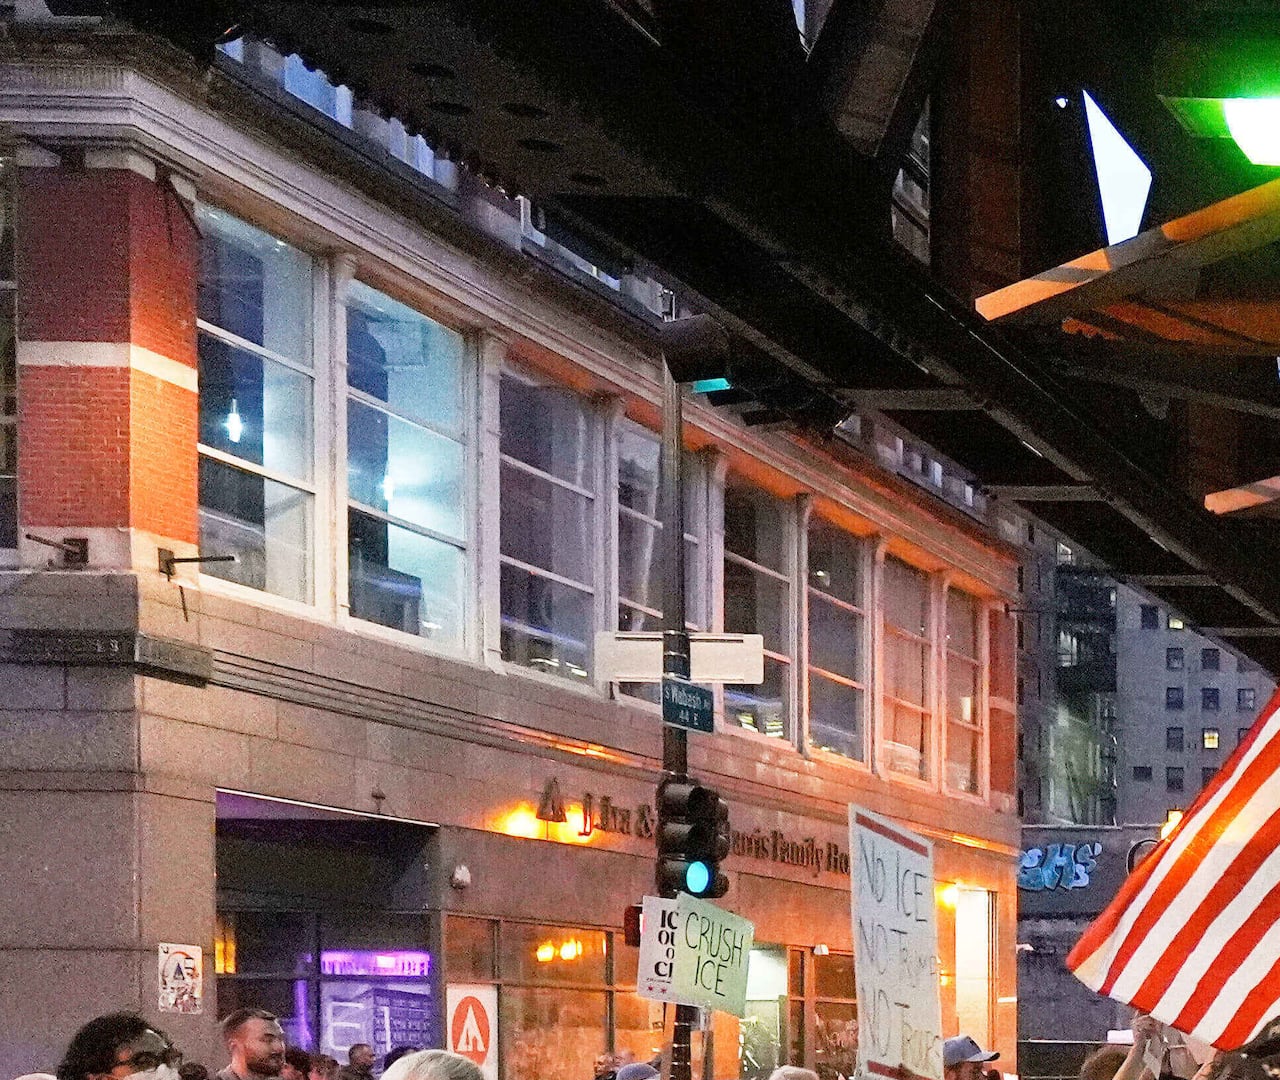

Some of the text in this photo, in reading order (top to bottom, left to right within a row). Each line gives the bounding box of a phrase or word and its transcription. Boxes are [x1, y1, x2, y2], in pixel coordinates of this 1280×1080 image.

[896, 849, 928, 922] ICE
[685, 911, 744, 968] CRUSH
[695, 956, 728, 997] ICE
